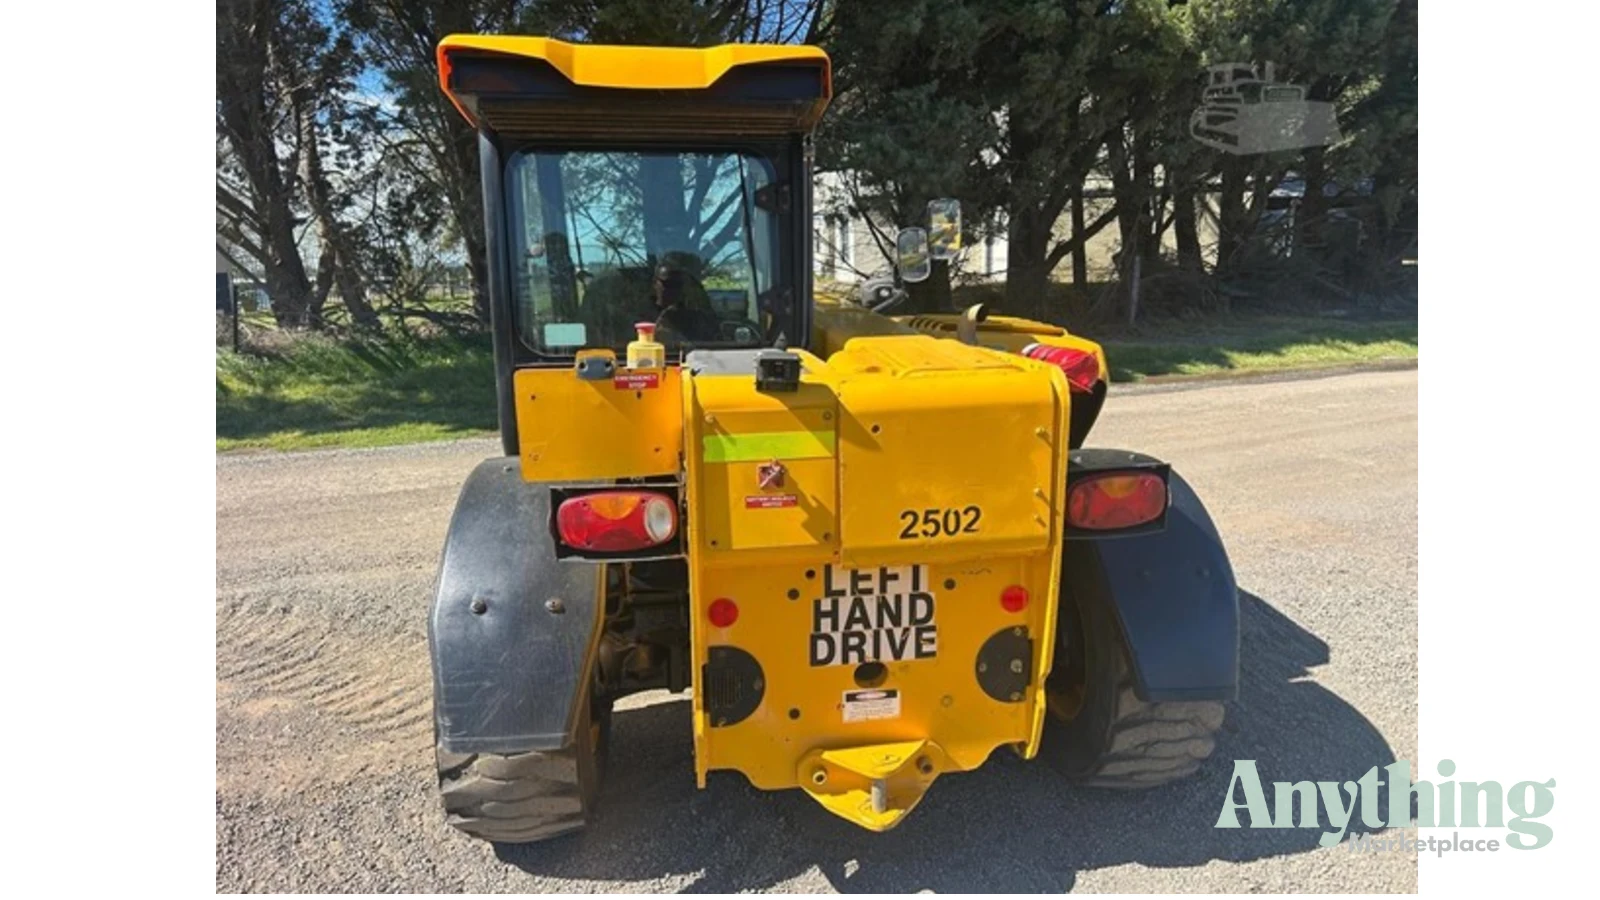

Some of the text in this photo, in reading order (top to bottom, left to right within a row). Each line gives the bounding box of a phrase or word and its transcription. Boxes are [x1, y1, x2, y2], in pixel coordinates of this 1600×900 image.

[900, 506, 982, 540] 2502
[813, 592, 935, 633] HAND
[810, 625, 937, 667] DRIVE
